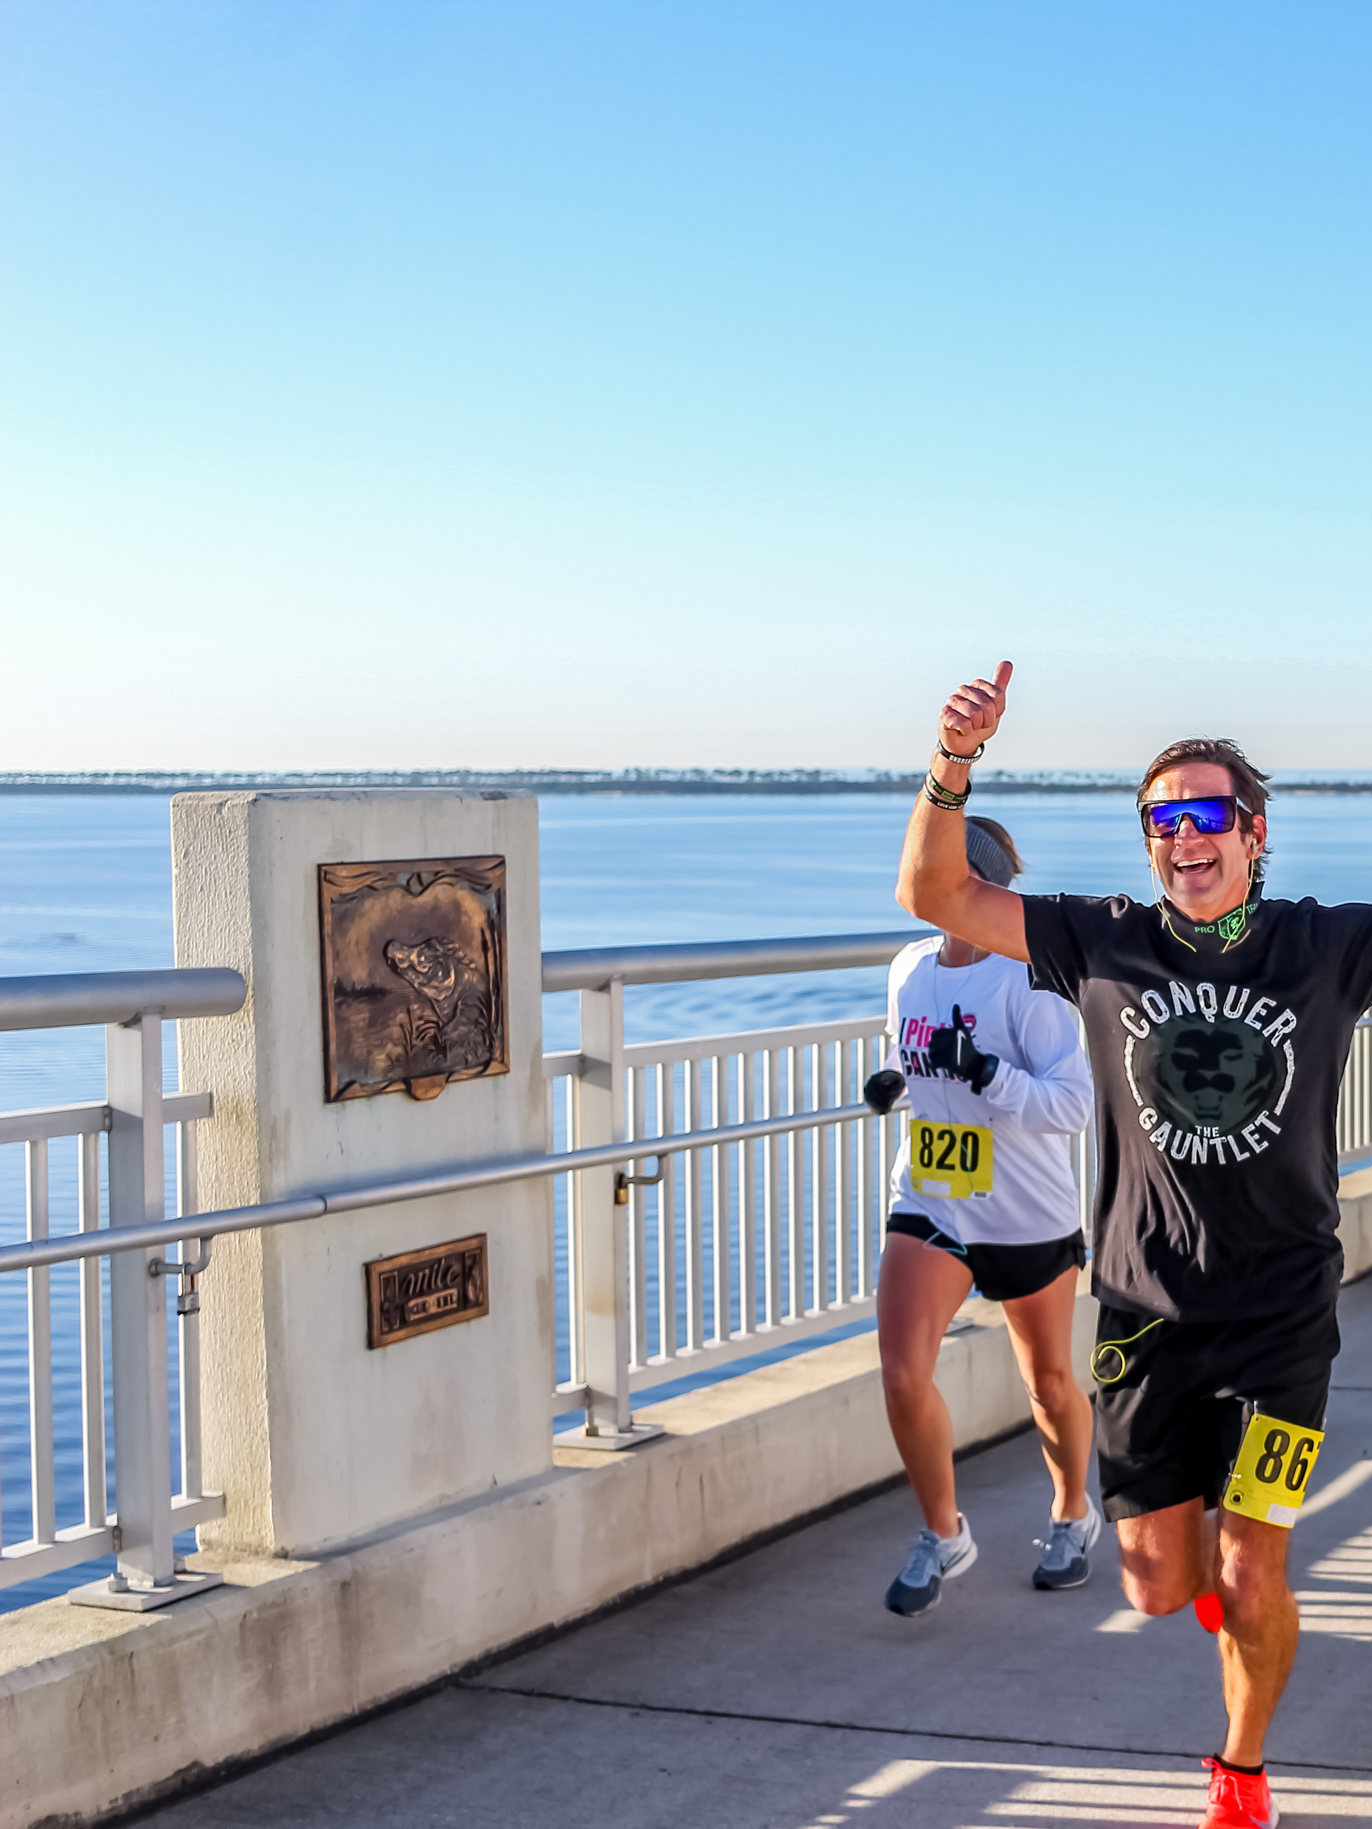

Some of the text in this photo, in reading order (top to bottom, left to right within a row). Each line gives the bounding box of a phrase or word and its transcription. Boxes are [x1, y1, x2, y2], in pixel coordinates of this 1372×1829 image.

[1194, 925, 1215, 934] PRO
[1120, 980, 1297, 1047] CONQUER
[919, 1126, 979, 1173] 820
[1138, 1107, 1281, 1165] GAUNTLET
[1195, 1125, 1219, 1137] THE
[1255, 1428, 1320, 1491] 86
